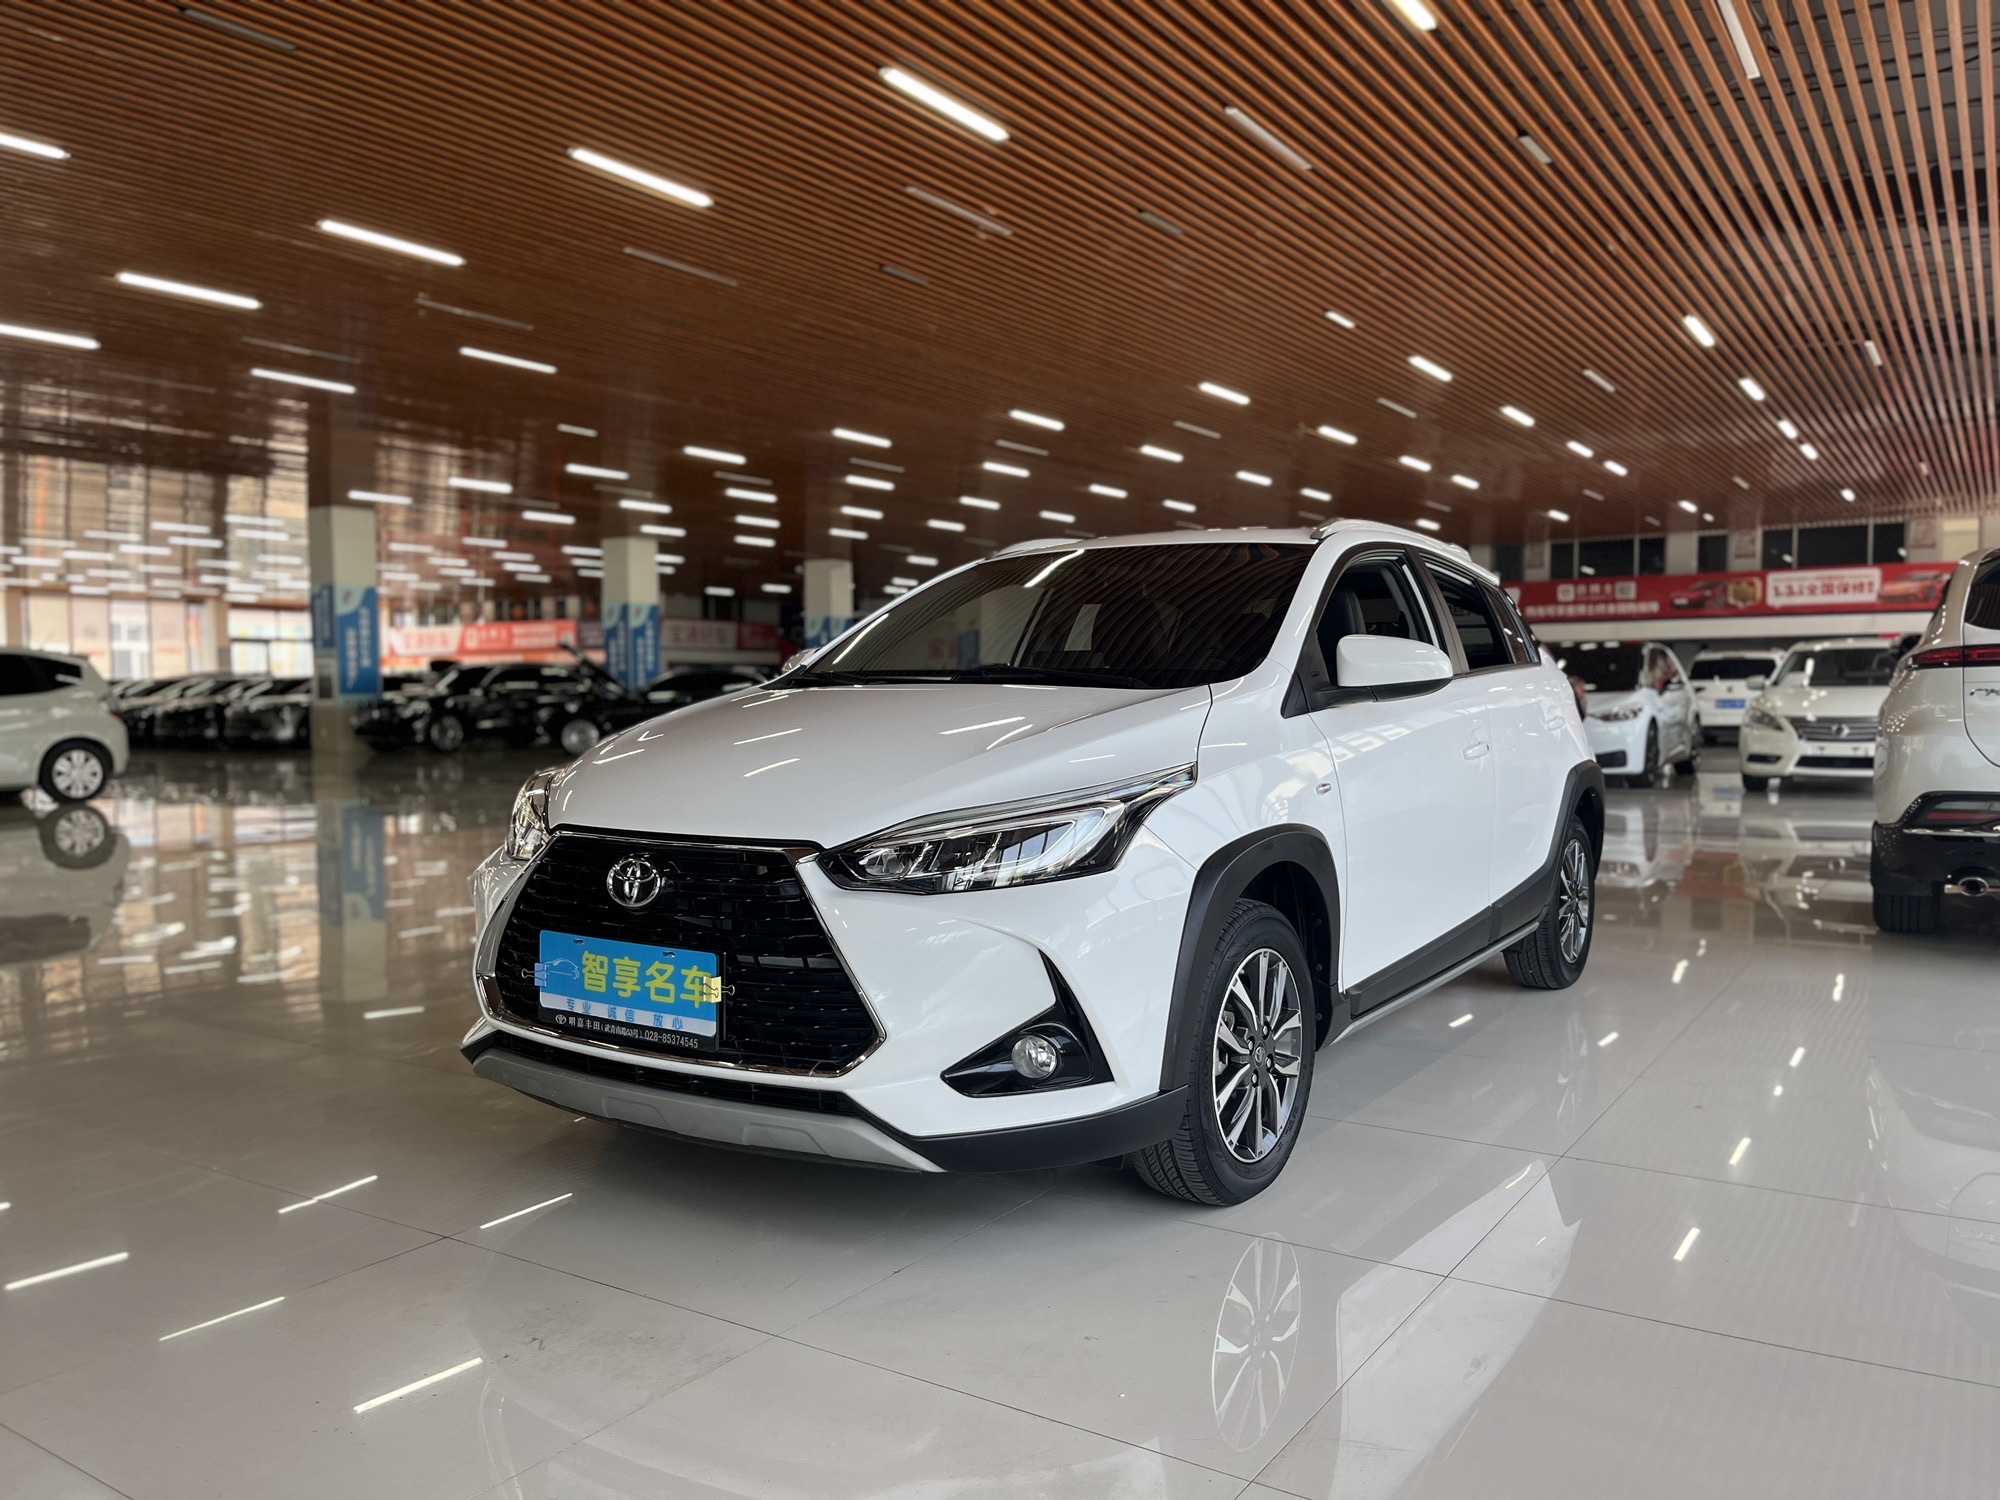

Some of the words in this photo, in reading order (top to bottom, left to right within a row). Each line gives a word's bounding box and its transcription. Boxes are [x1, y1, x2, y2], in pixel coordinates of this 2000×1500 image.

[582, 950, 710, 1008] 智享名车
[566, 998, 592, 1014] 专业
[607, 1005, 635, 1023] 诚信
[653, 1013, 683, 1030] 放心
[644, 1029, 699, 1049] 028-85374545
